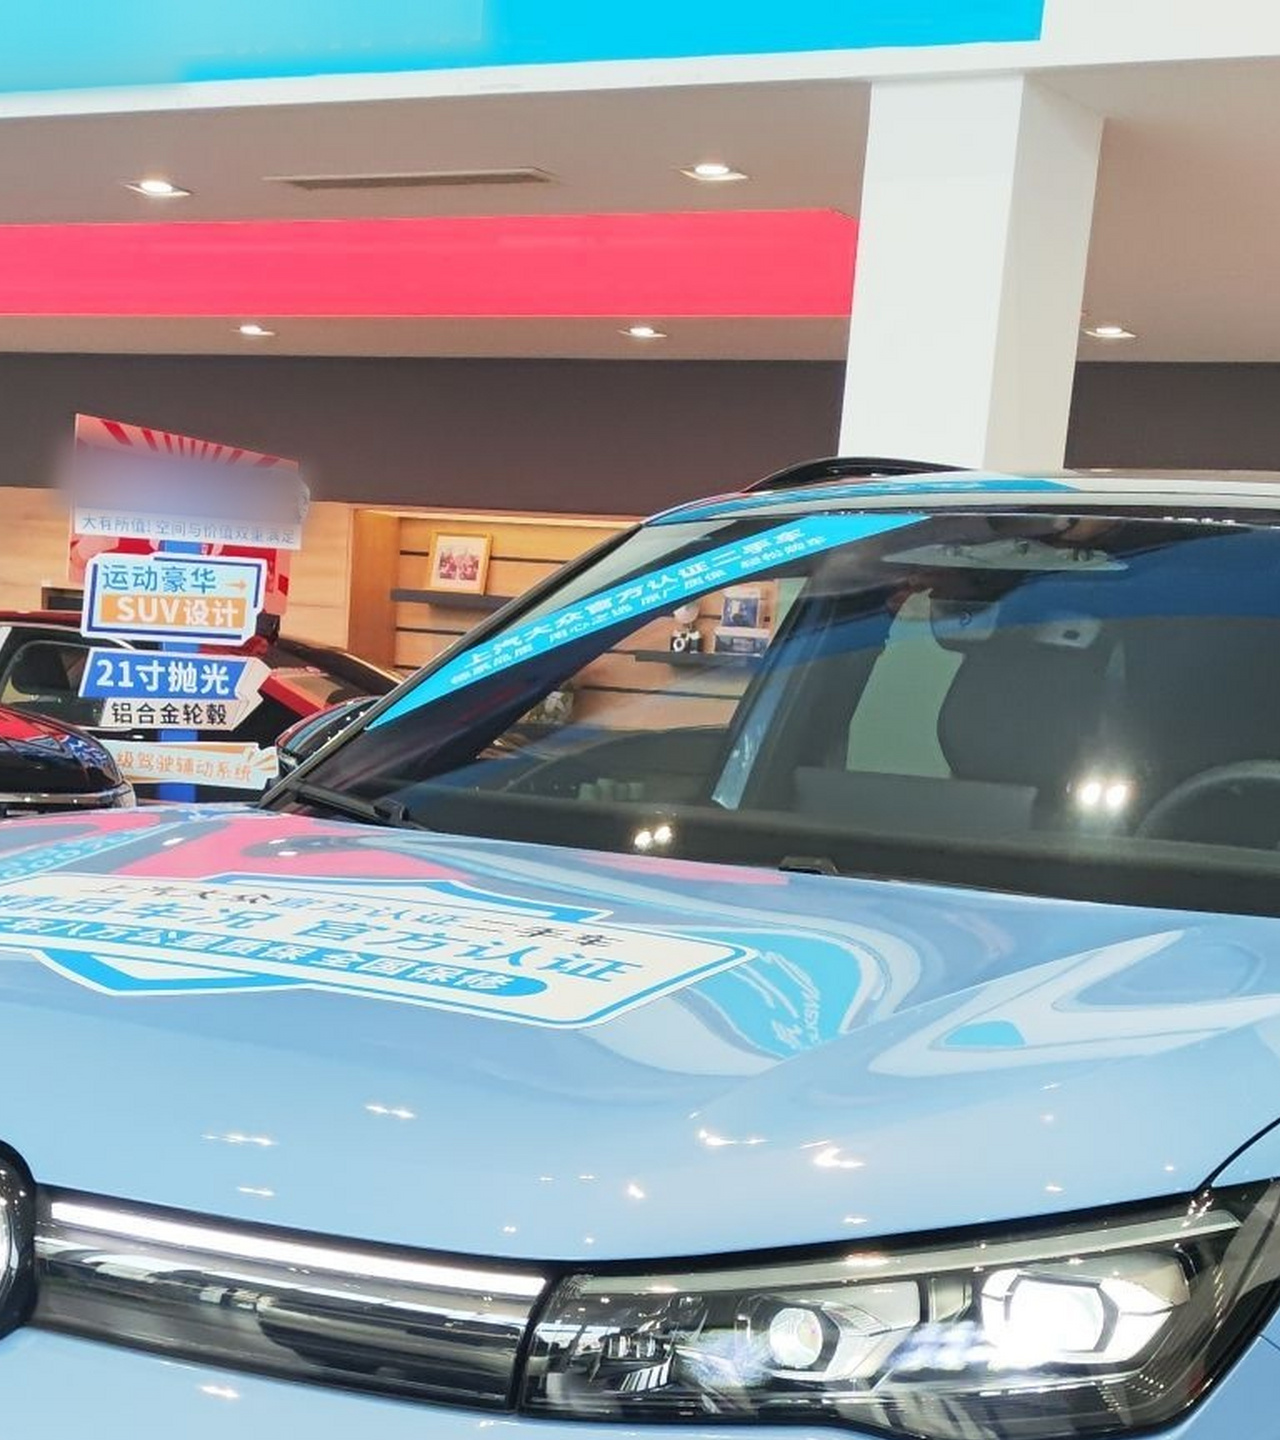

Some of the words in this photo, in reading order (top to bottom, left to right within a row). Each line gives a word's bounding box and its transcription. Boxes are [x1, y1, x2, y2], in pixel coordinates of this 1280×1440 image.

[101, 564, 217, 594] 运动豪华
[117, 597, 239, 628] SUV设计
[463, 529, 806, 669] 上汽大众官方认证二手车
[96, 658, 230, 695] 21寸抛光
[112, 702, 227, 726] 铝合金轮毂
[79, 885, 625, 949] 上汽大众官方认证二手车
[293, 919, 644, 983] 官方认证
[310, 951, 514, 991] 全国保修
